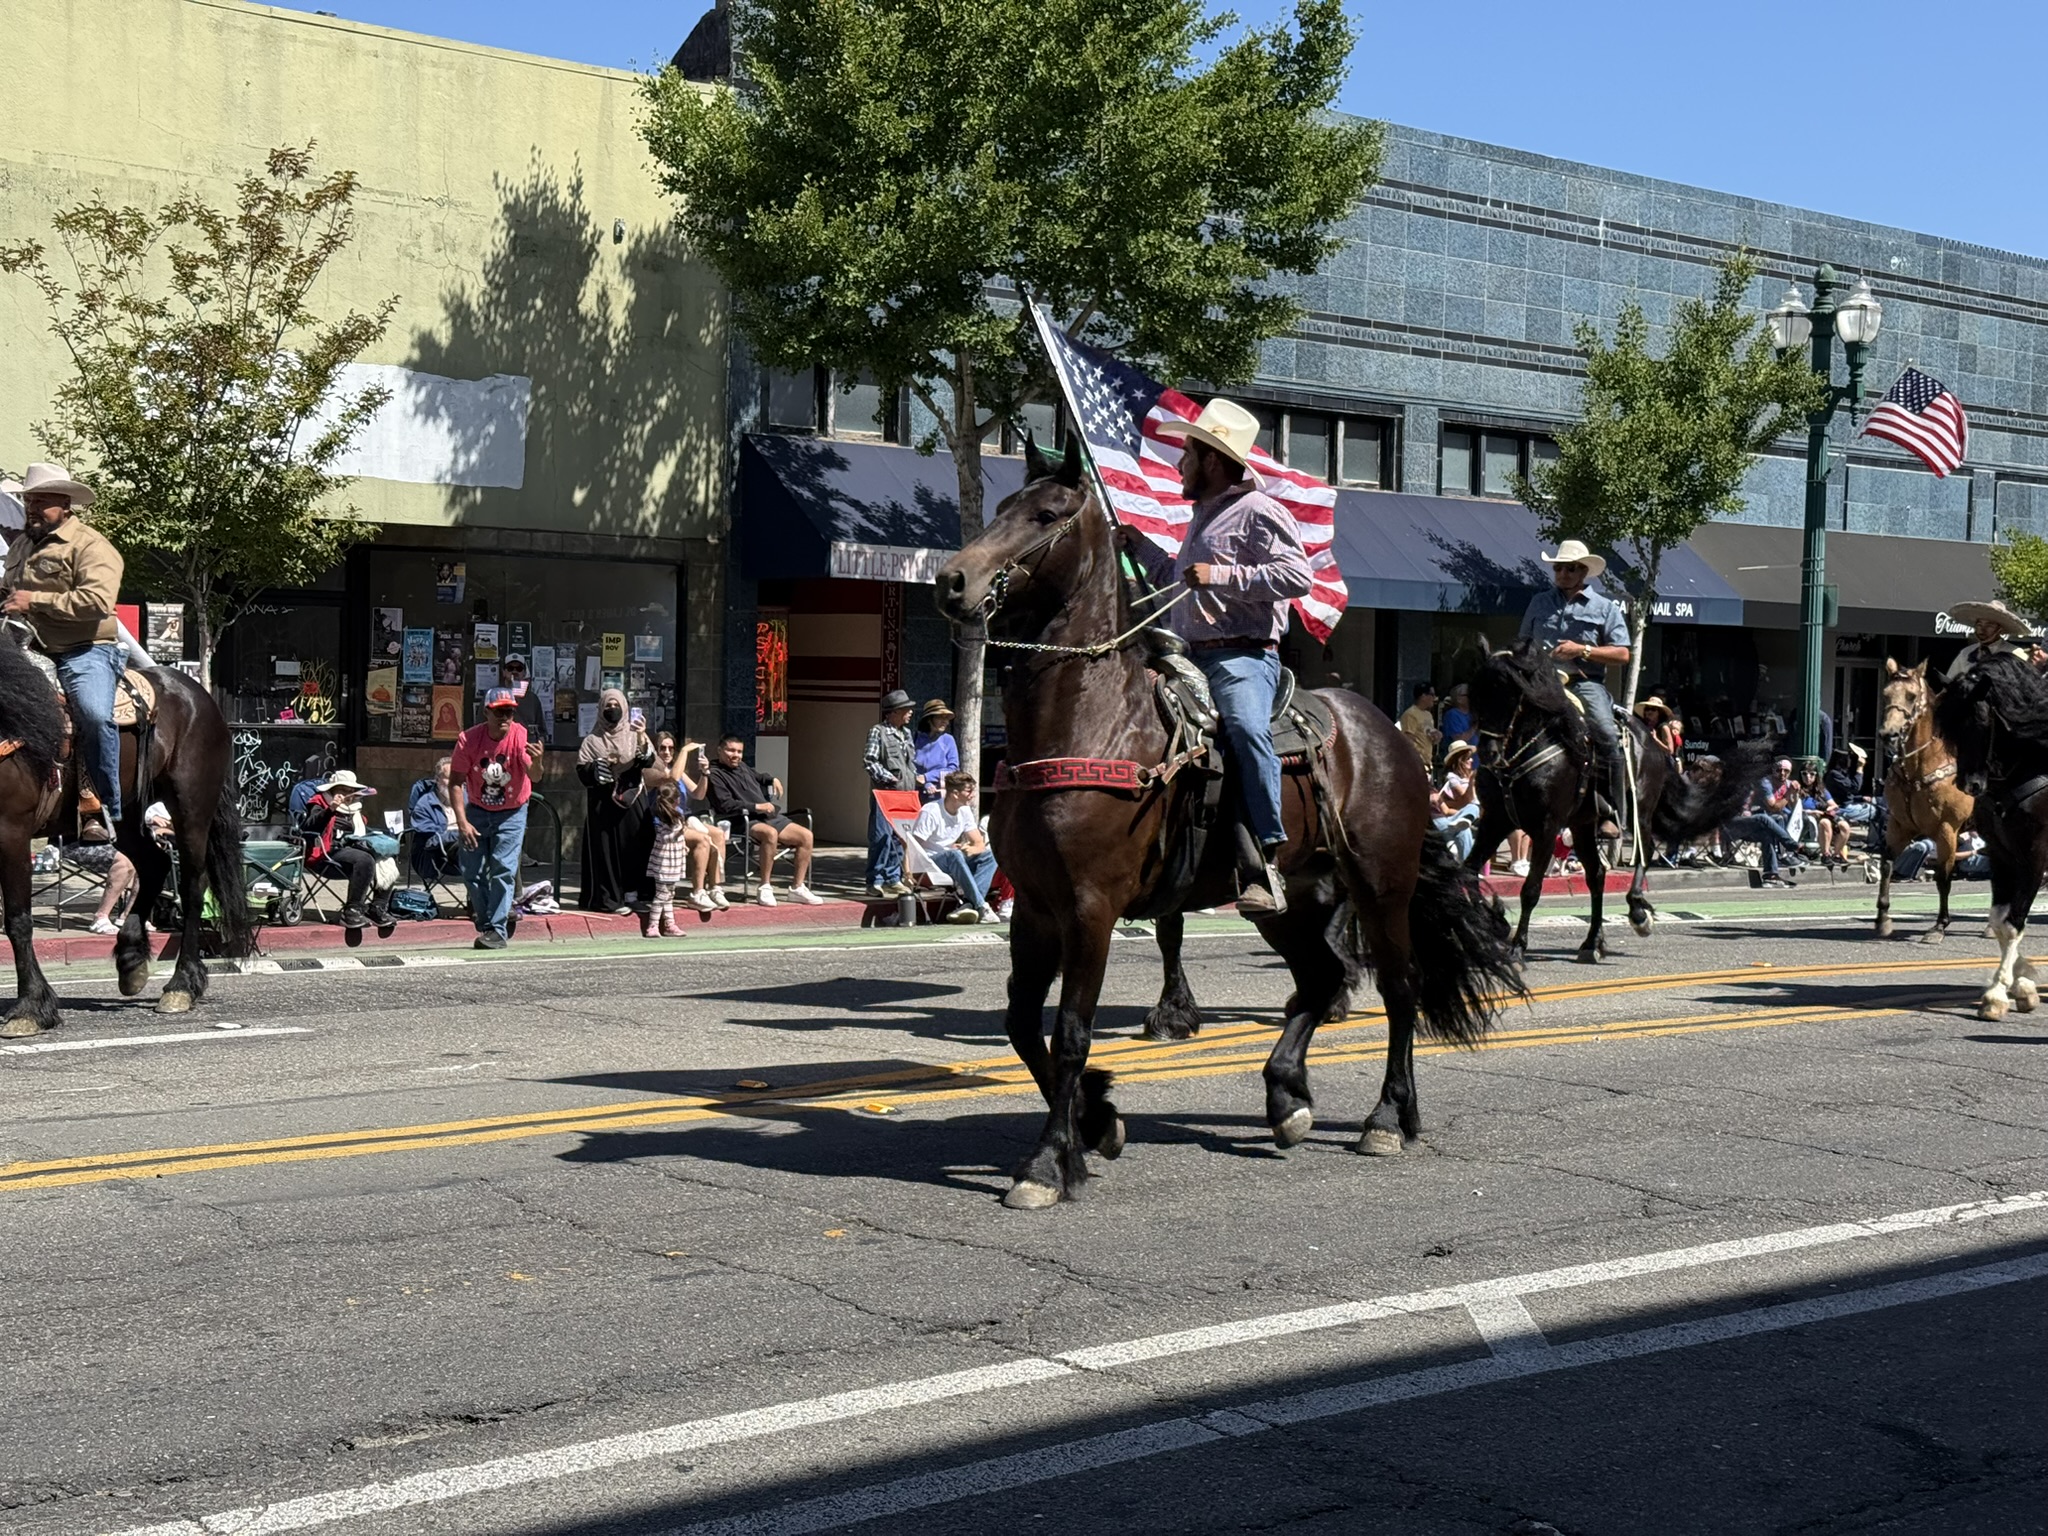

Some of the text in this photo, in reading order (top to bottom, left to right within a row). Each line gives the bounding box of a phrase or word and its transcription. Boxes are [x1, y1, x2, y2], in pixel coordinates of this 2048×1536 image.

[1649, 601, 1672, 616] NAIL
[1674, 602, 1694, 617] SPA
[1684, 739, 1710, 751] Sunday
